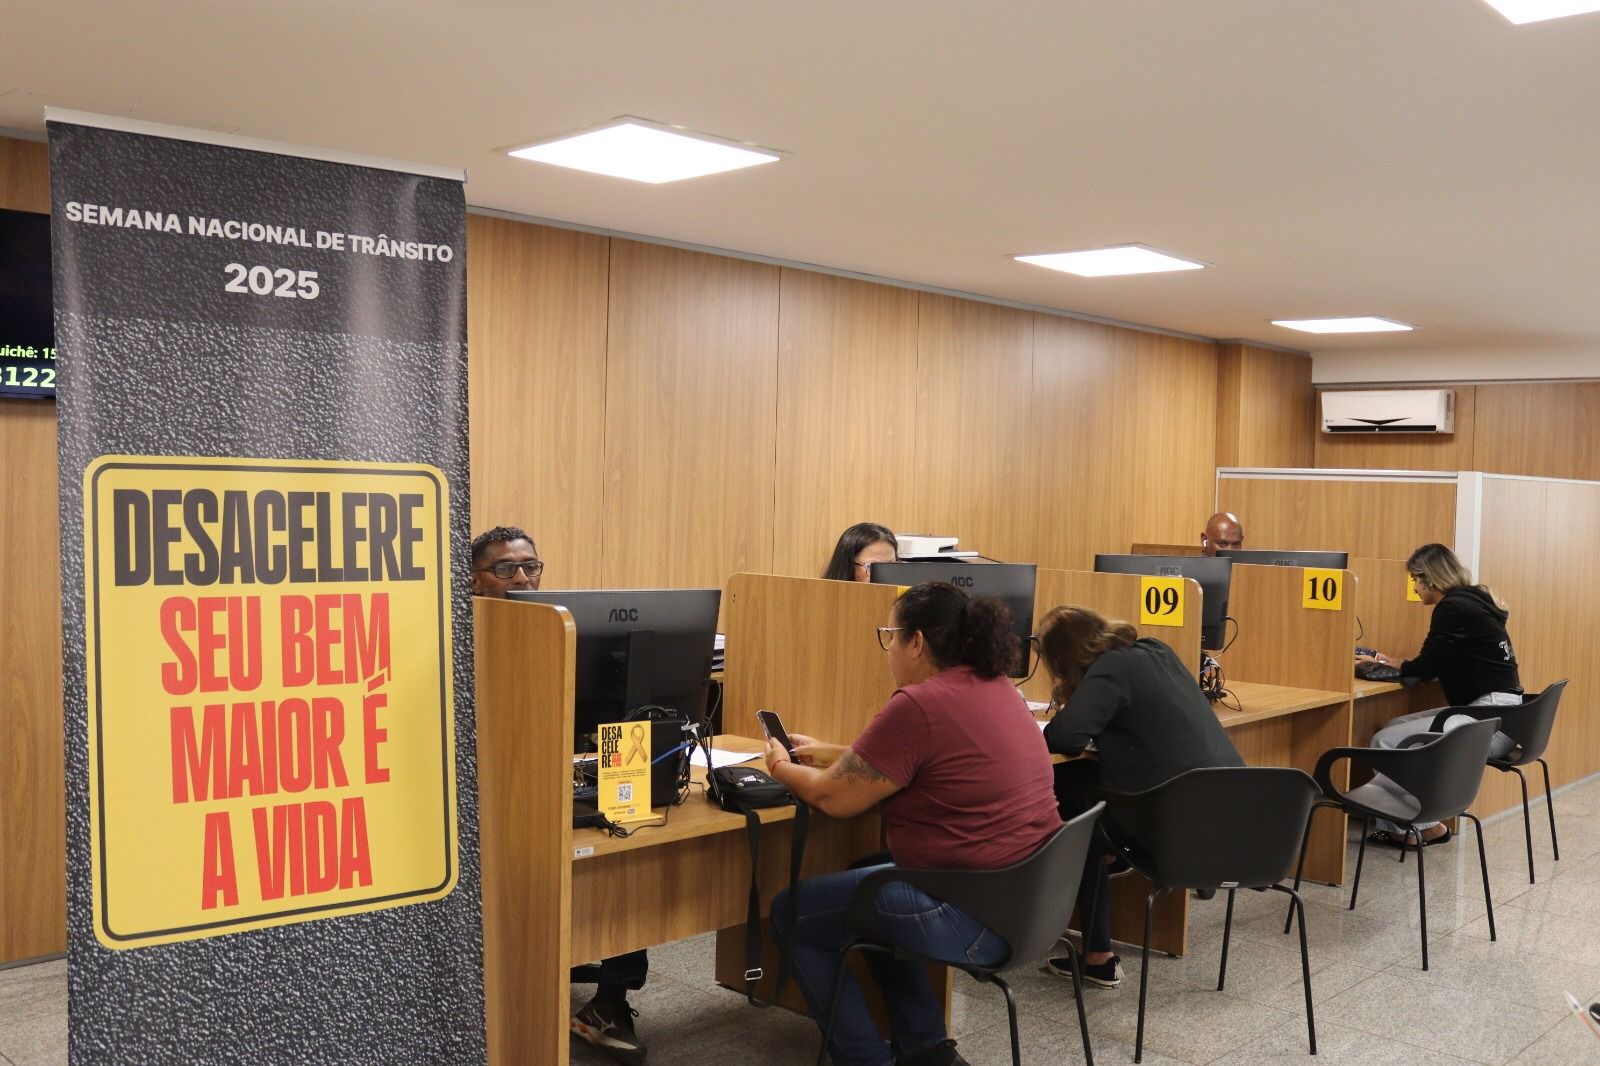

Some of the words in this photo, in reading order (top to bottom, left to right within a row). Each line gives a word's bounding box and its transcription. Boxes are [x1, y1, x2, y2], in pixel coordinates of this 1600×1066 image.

[65, 201, 183, 234] SEMANA
[188, 216, 313, 248] NACIONAL
[316, 230, 345, 251] DE
[348, 233, 454, 263] TRÂNSITO
[224, 263, 320, 300] 2025
[113, 488, 426, 587] DESACELERE
[1145, 586, 1179, 616] 09
[1308, 576, 1337, 602] 10
[608, 608, 639, 623] AOC
[160, 595, 263, 696] SEU
[280, 592, 391, 689] BEM
[169, 697, 349, 804] MAIOR
[362, 673, 391, 785] É
[602, 726, 622, 740] DESA
[602, 740, 618, 754] CELE
[602, 754, 611, 768] RE
[201, 811, 239, 911] A
[252, 796, 373, 902] VIDA
